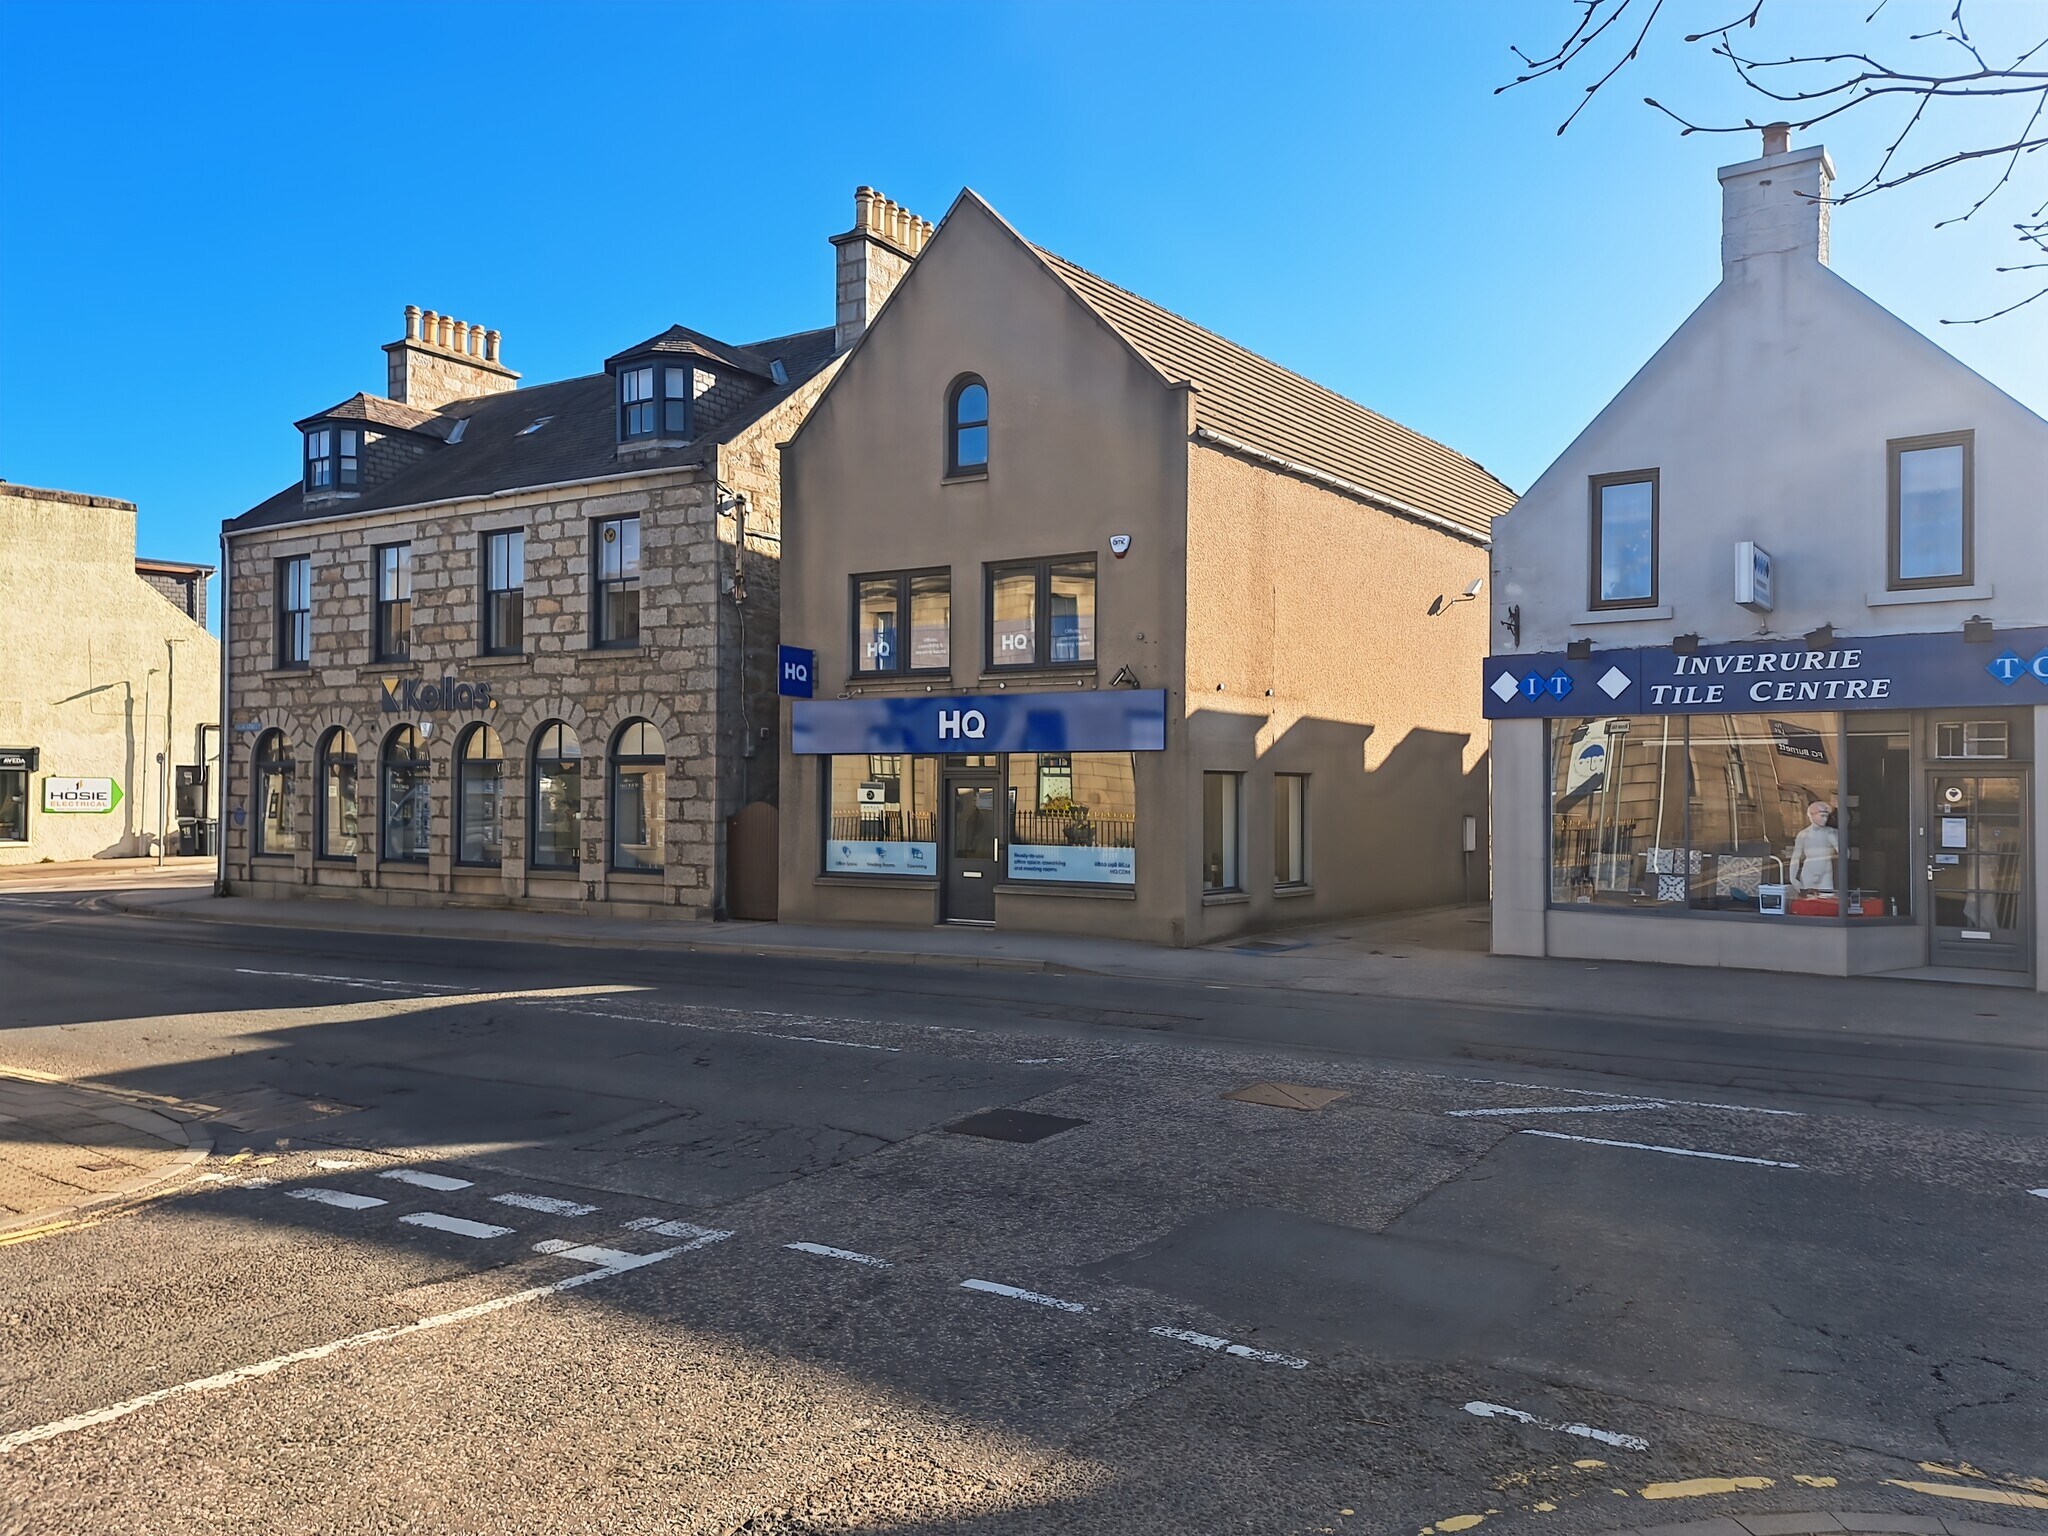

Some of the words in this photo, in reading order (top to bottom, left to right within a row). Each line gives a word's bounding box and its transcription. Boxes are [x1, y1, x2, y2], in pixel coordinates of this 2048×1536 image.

[867, 641, 890, 658] HQ
[1001, 634, 1028, 651] HQ
[784, 662, 807, 682] HQ
[1673, 649, 1862, 676] INVERURIE
[1650, 684, 1724, 705] TILE
[1749, 678, 1891, 702] CENTRE
[938, 710, 986, 739] HQ
[50, 792, 107, 800] HOSIE
